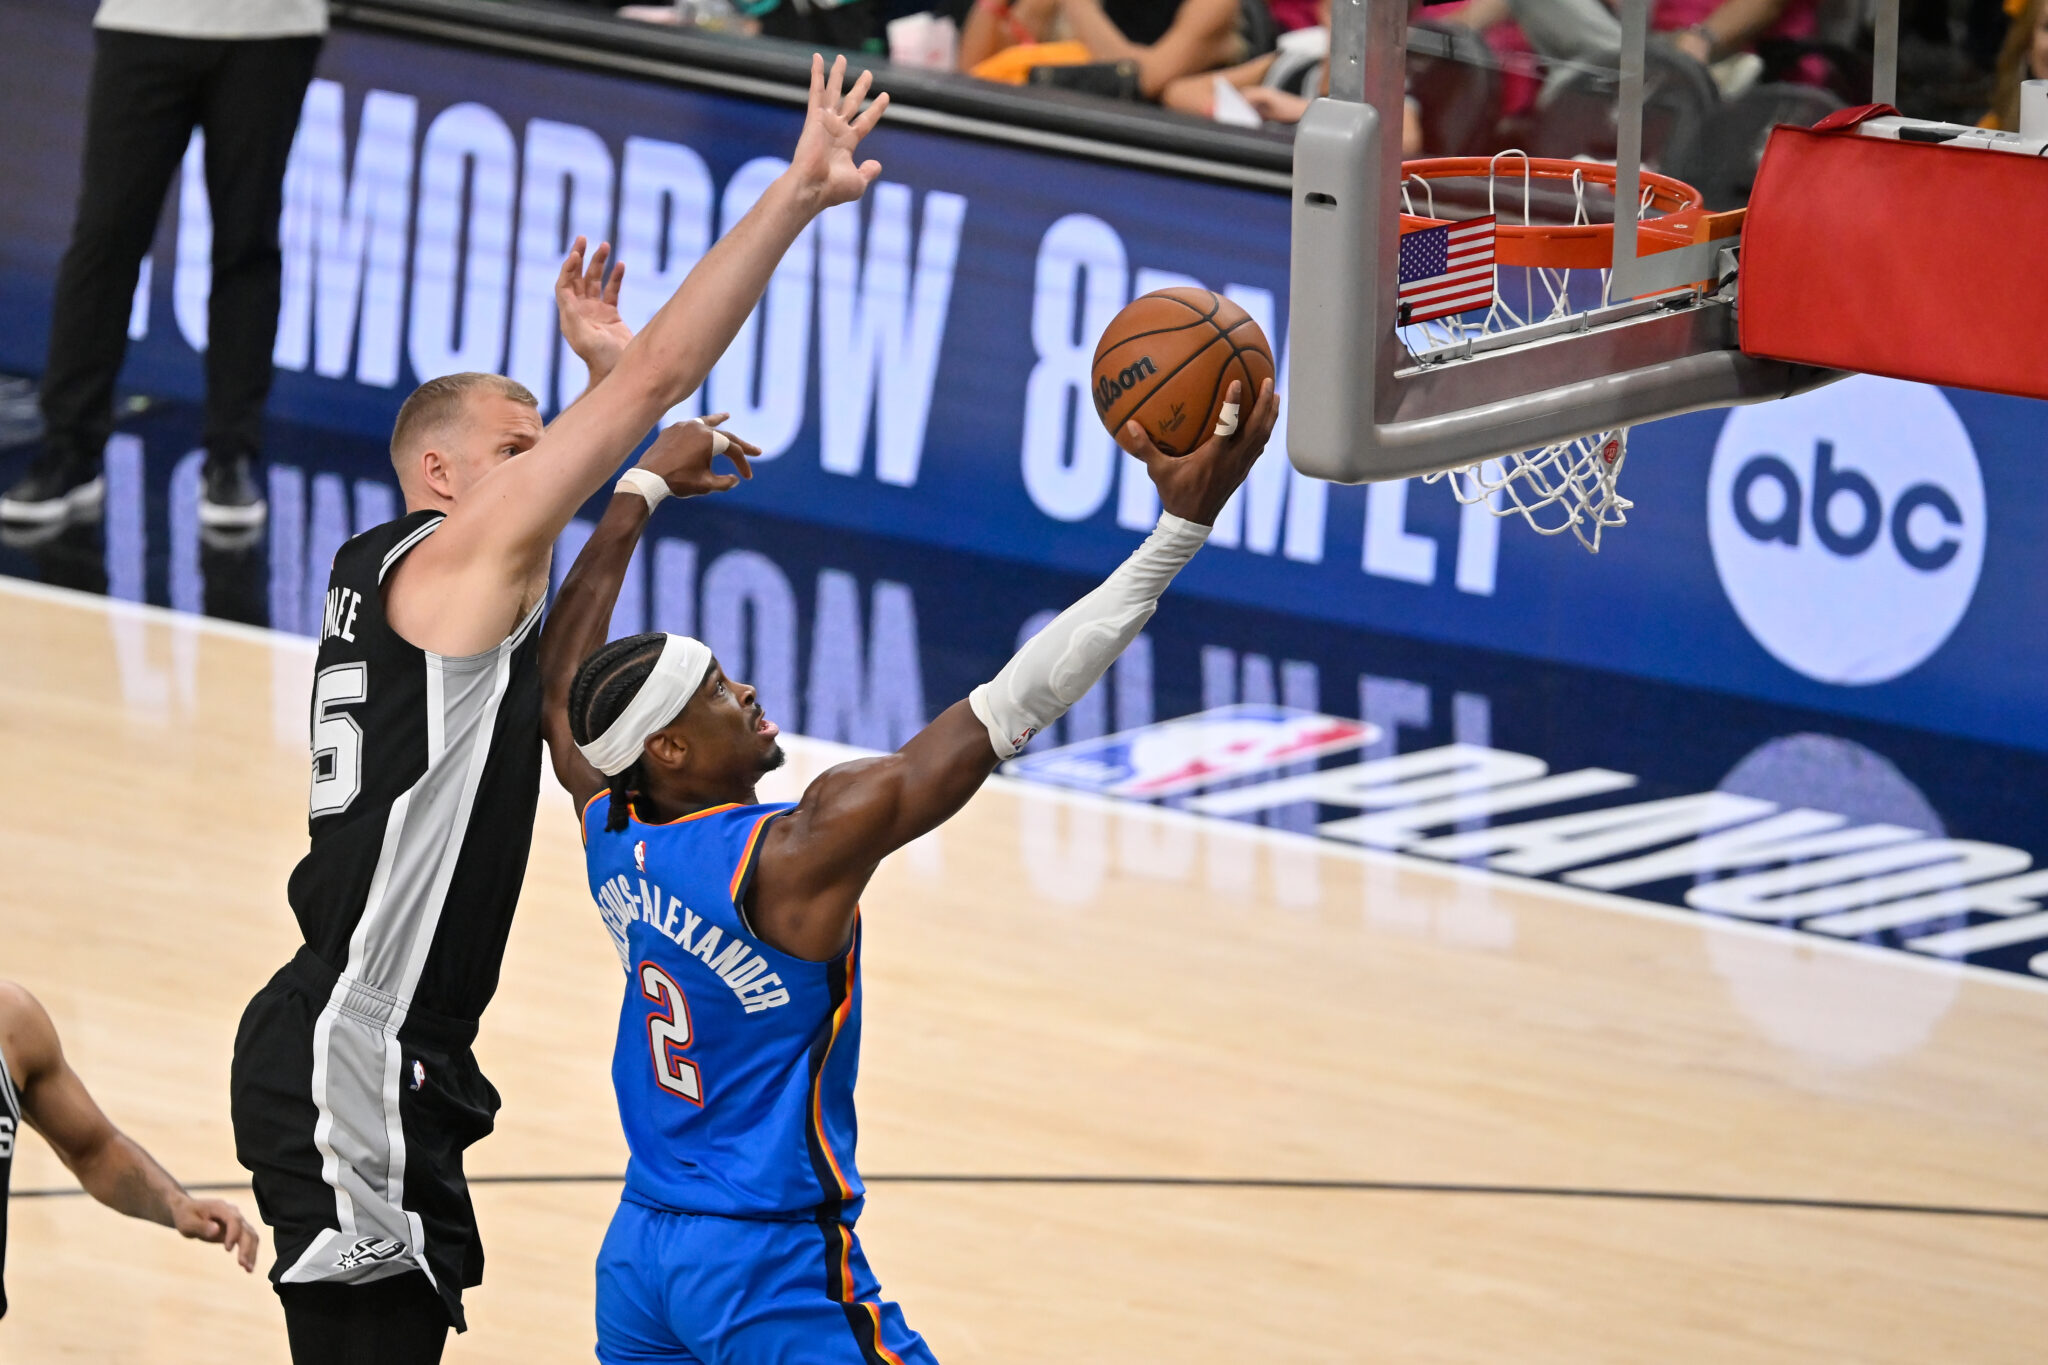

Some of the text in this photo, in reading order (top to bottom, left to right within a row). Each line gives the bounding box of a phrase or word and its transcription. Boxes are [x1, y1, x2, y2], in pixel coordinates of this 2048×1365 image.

[128, 78, 967, 488] MORROW
[1093, 355, 1157, 418] ilson
[1732, 437, 1963, 572] abc
[310, 660, 368, 820] 5
[1183, 742, 2048, 978] PLAYOF
[638, 960, 704, 1108] 2
